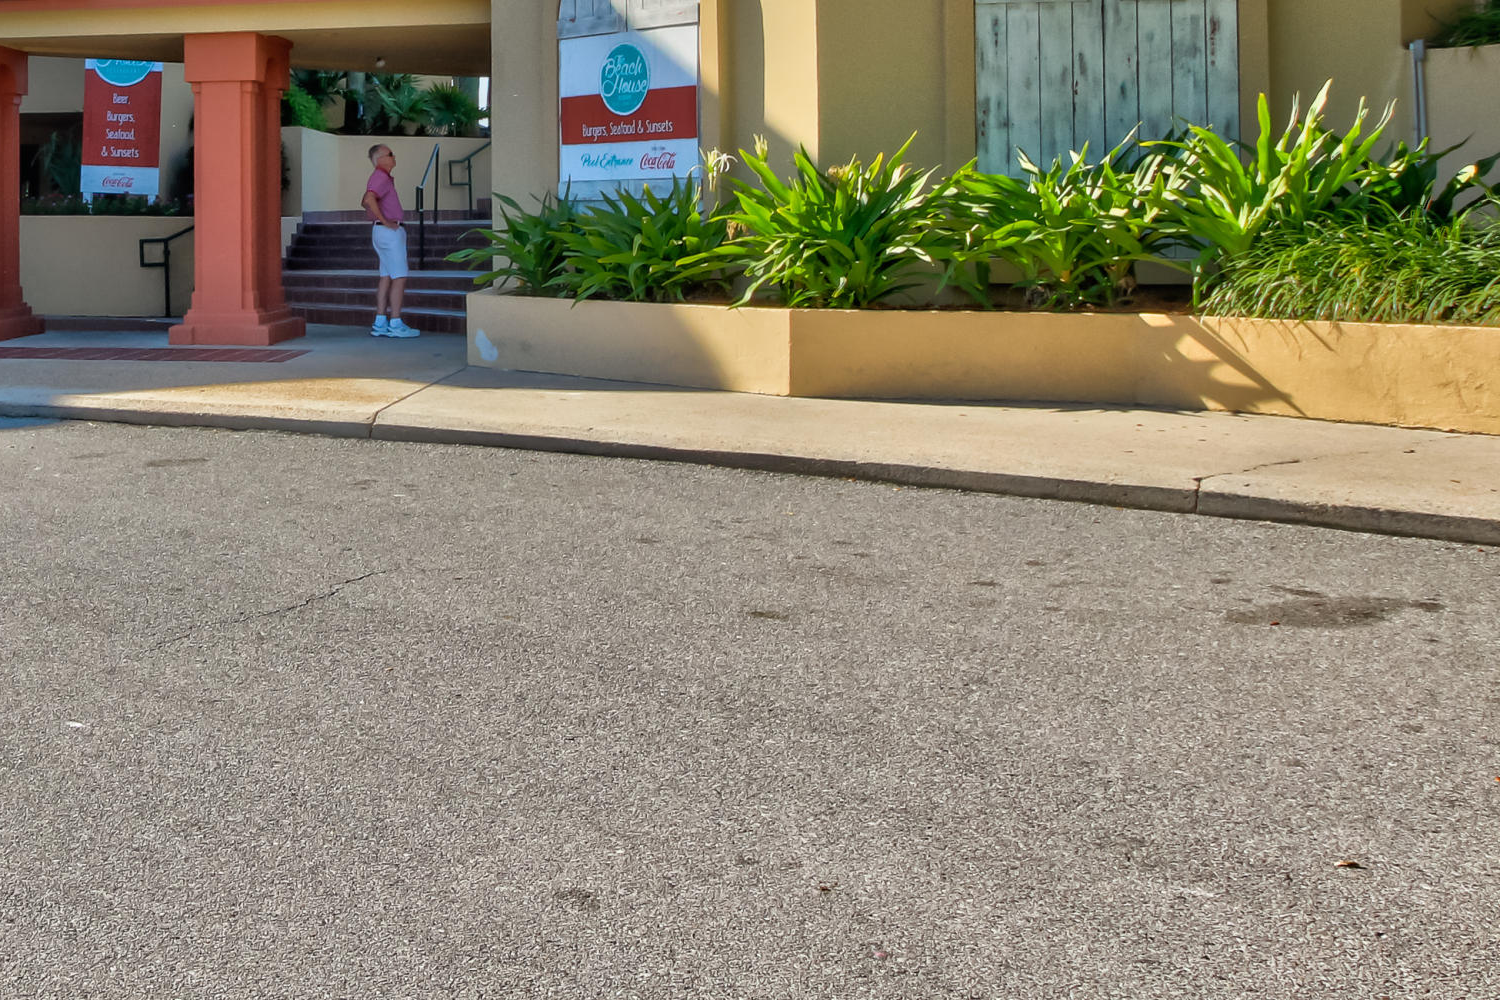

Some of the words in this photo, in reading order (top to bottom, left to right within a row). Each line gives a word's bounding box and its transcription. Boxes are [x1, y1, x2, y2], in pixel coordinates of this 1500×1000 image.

[604, 55, 643, 78] Beach
[602, 74, 647, 97] House
[609, 119, 636, 136] Seafood
[638, 120, 644, 133] &
[645, 119, 674, 134] Sunsets
[101, 146, 108, 157] &
[110, 146, 140, 158] Sunsets
